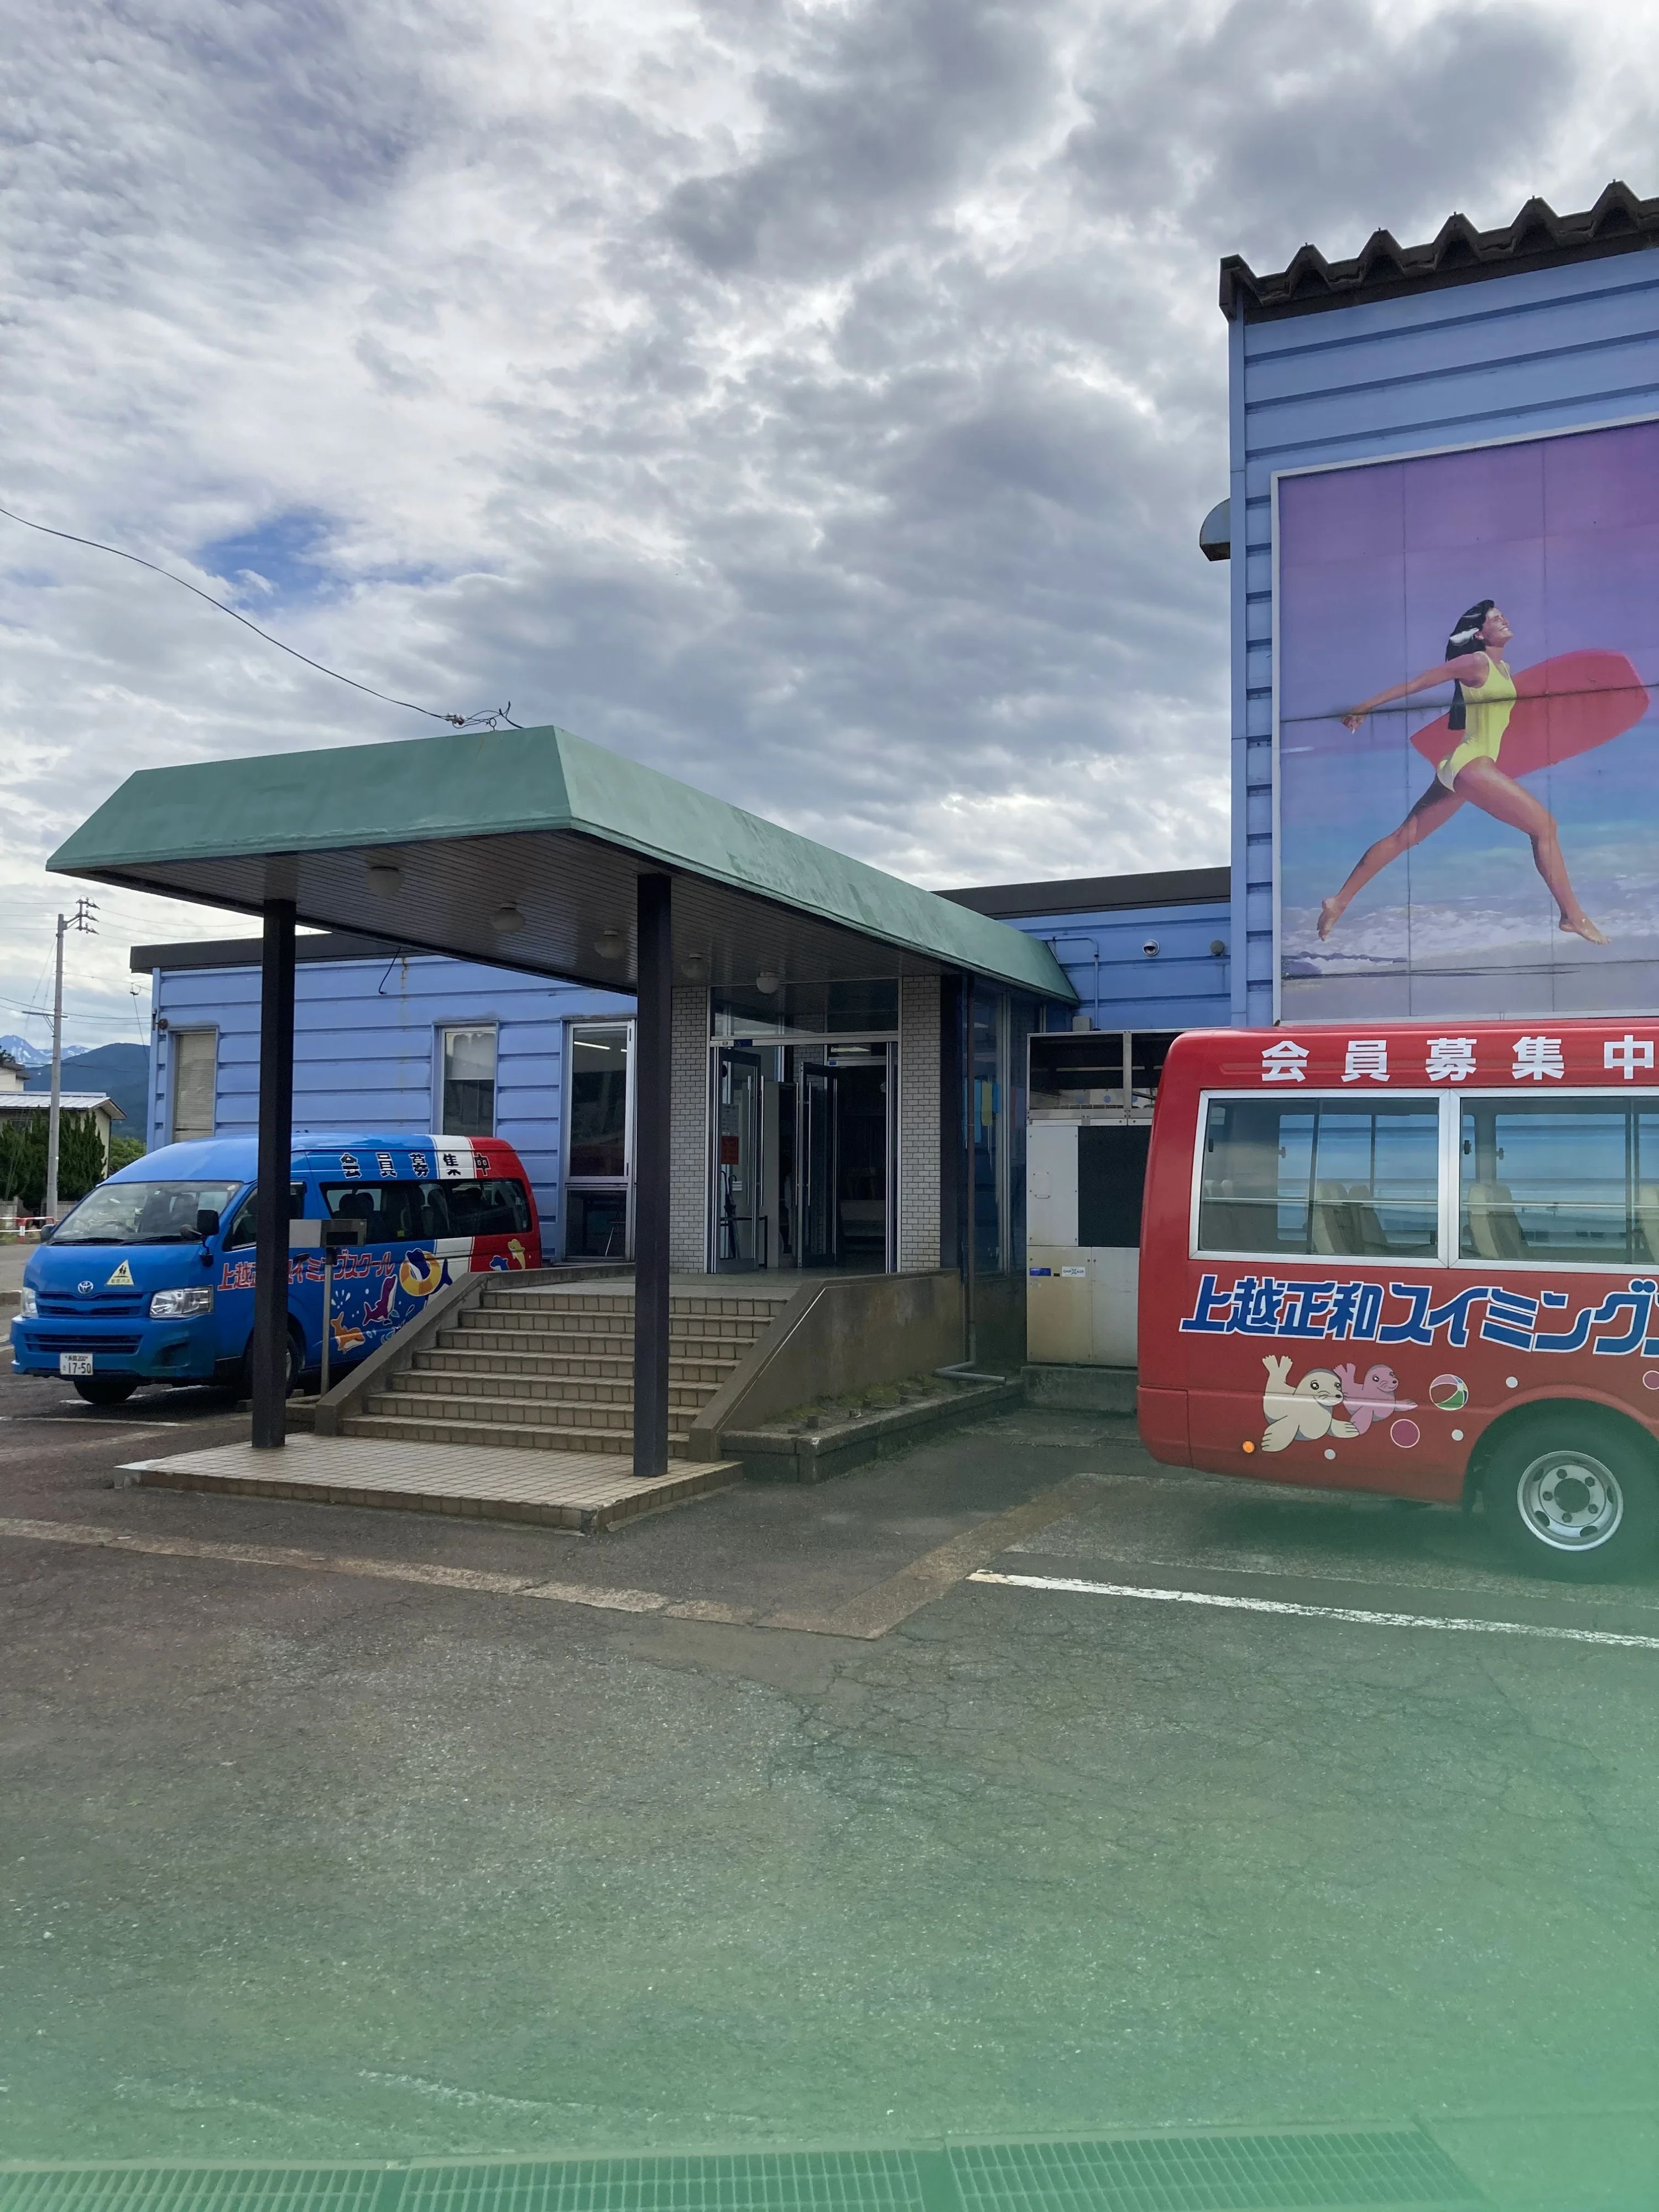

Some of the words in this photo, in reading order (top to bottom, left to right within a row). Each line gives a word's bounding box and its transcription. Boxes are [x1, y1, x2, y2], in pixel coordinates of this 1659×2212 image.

[1261, 1034, 1655, 1083] 会員募集中
[340, 1152, 492, 1179] 会員募集中
[1178, 1274, 1659, 1357] 上越正和スイミング
[68, 1362, 91, 1374] 17-50
